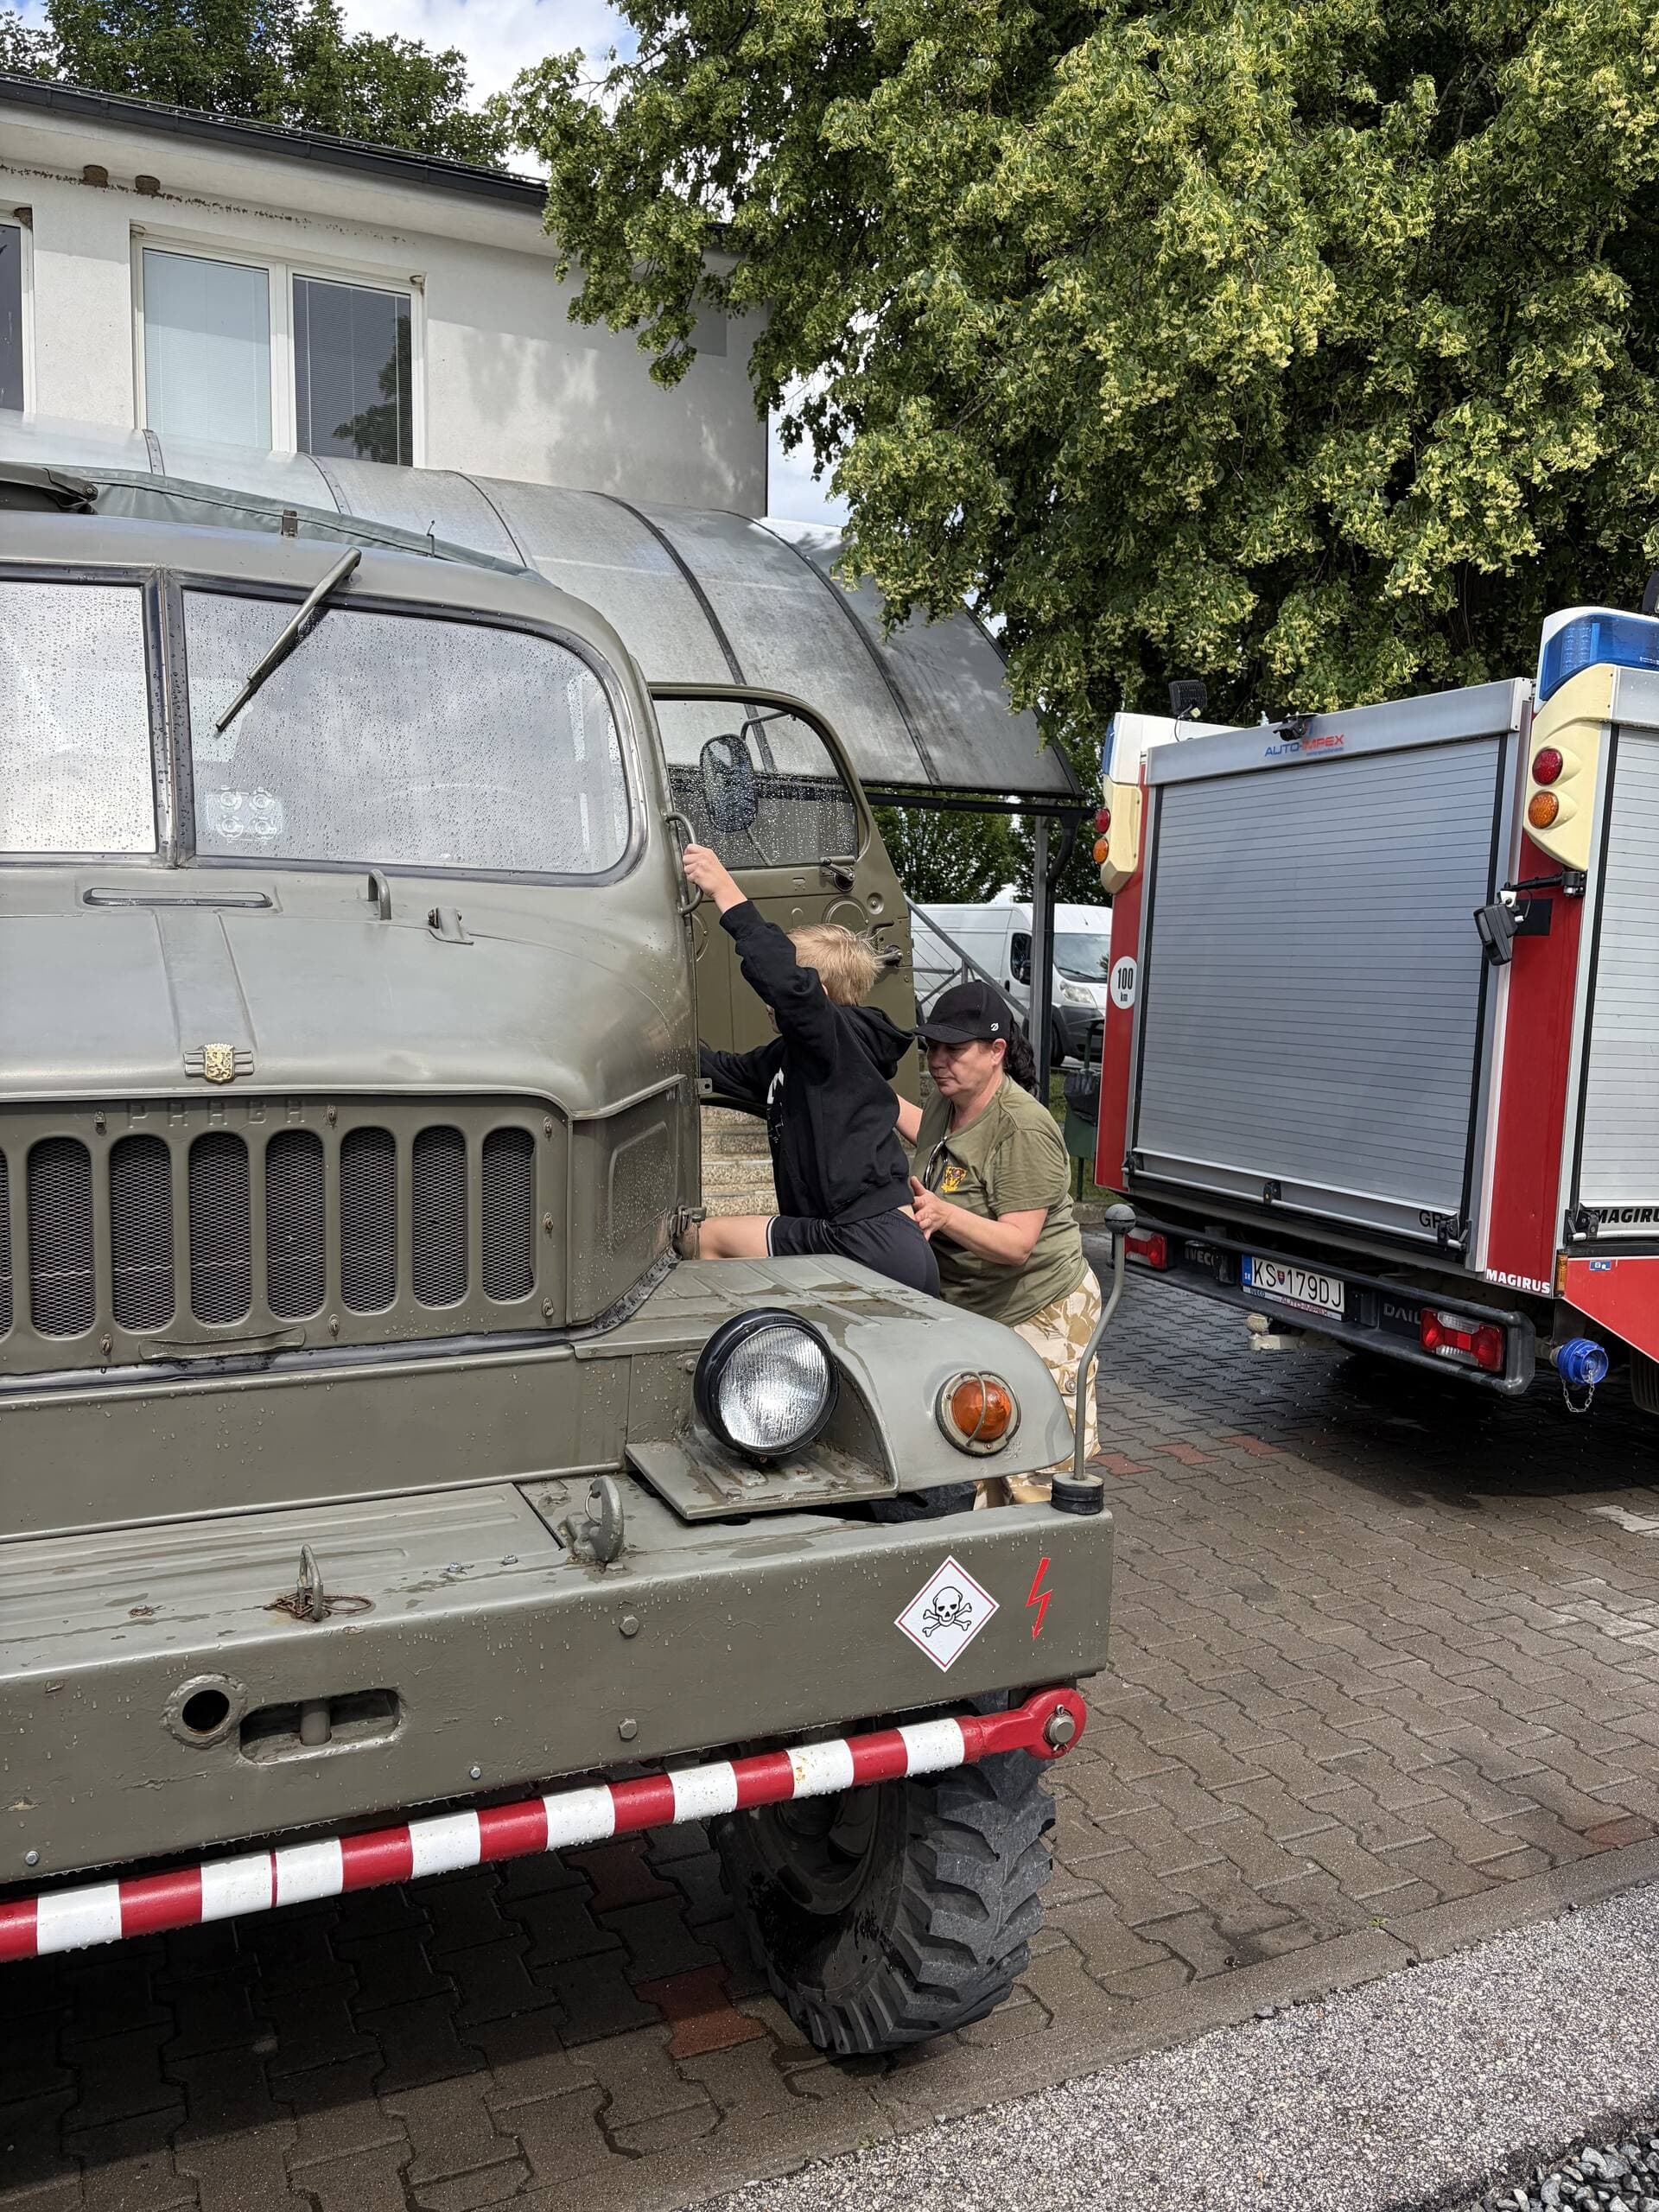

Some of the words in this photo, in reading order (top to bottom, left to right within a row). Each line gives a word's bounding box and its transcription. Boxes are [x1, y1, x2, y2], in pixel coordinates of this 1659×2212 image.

[1264, 734, 1344, 757] AUTO-IMPEX
[1117, 967, 1134, 990] 100
[1120, 991, 1128, 1002] km
[1253, 1258, 1276, 1287] KS
[1287, 1268, 1342, 1307] 179DJ
[1486, 1268, 1551, 1294] MAGIRUS
